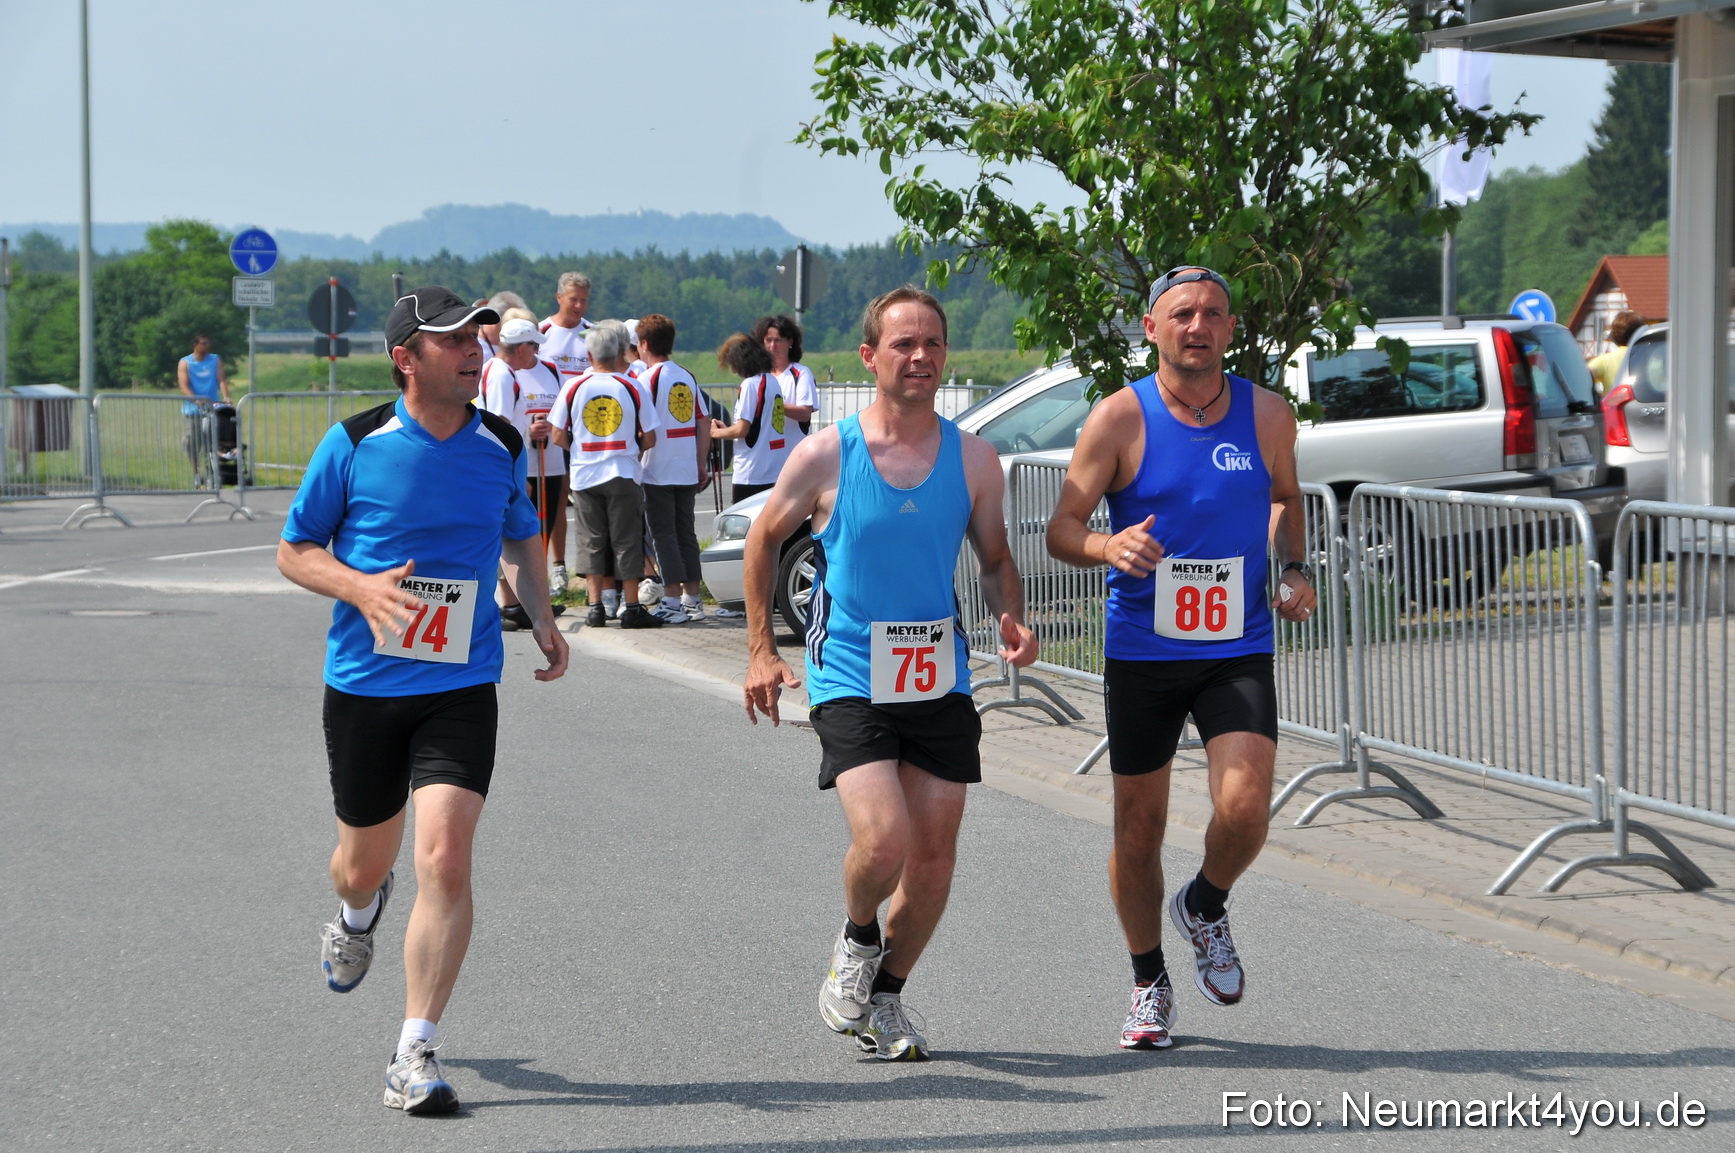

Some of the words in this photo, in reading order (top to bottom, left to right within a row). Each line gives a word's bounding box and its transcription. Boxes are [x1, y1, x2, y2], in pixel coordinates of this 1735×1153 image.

[1171, 563, 1213, 574] MEYER
[1171, 573, 1214, 582] WERBUNG
[400, 579, 444, 594] MEYER
[1175, 585, 1227, 632] 86
[401, 604, 449, 653] 74
[886, 625, 928, 636] MEYER
[886, 635, 928, 643] WERBUNG
[891, 646, 937, 693] 75
